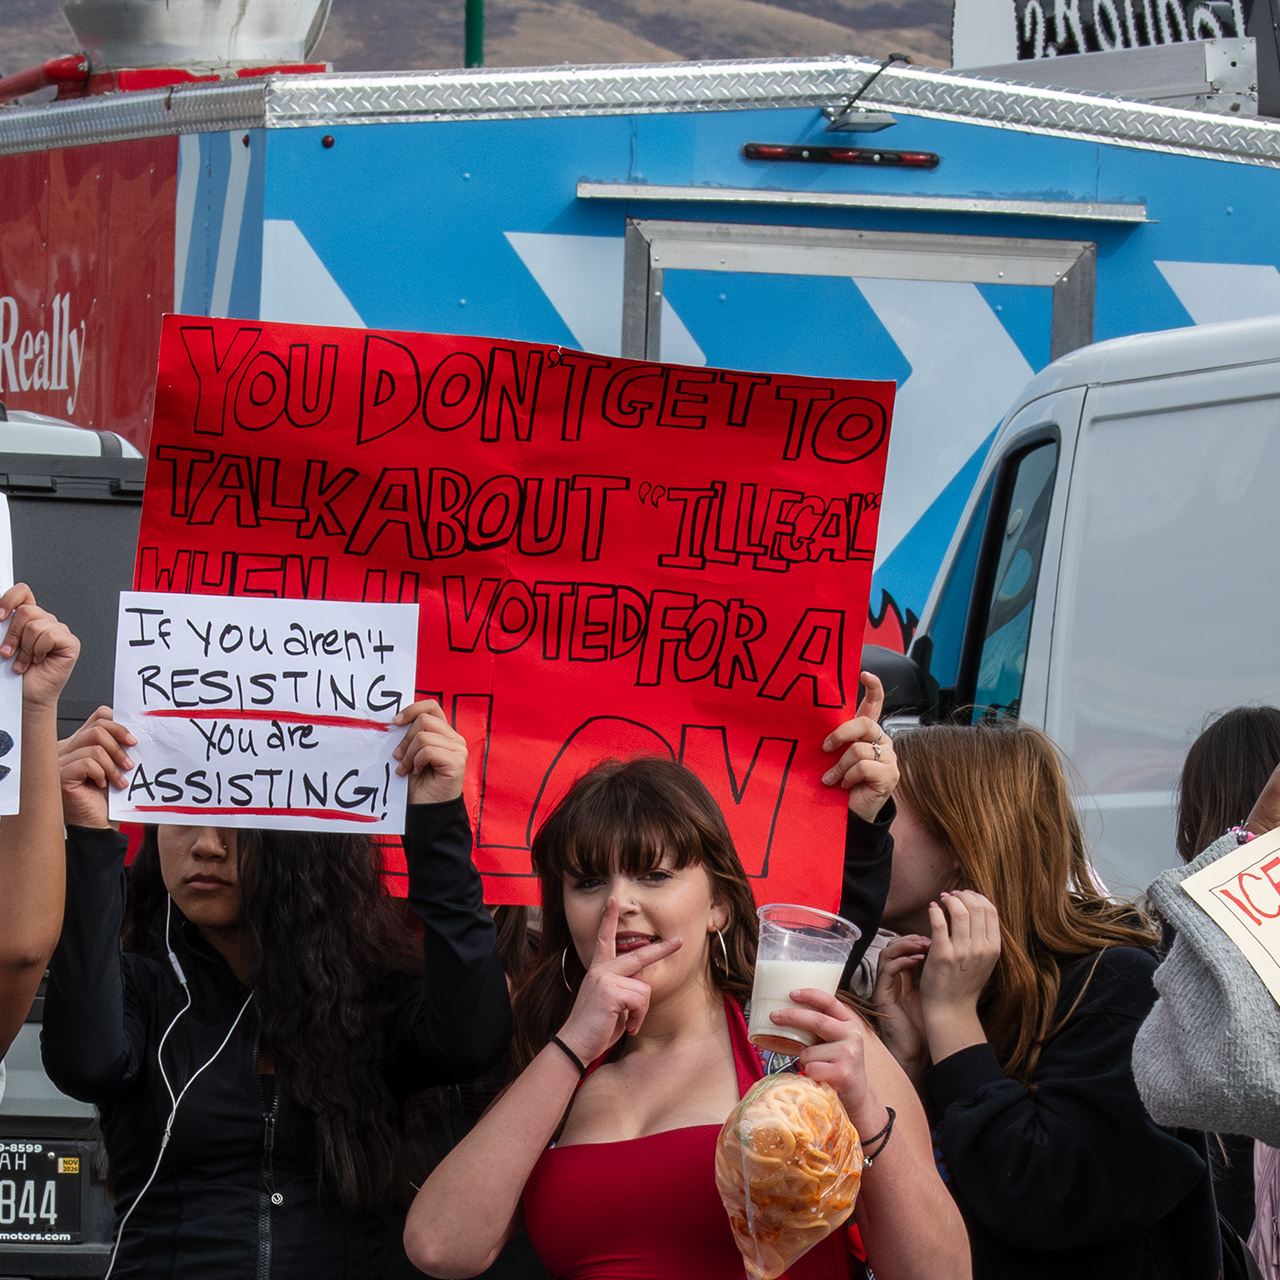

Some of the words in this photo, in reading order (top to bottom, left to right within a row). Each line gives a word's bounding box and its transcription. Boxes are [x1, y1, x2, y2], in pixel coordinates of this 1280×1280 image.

[180, 326, 339, 436] YOU
[357, 335, 611, 444] DON'T
[601, 365, 773, 430] GET
[770, 385, 888, 464] TO
[155, 445, 359, 540] TALK
[345, 467, 629, 562] ABOUT
[125, 607, 171, 650] If
[283, 622, 395, 664] aren't
[444, 574, 644, 663] VOTED
[635, 590, 767, 689] FOR
[760, 607, 847, 708] A
[137, 664, 402, 717] RESISTING
[266, 719, 319, 751] are
[128, 762, 390, 821] ASSISTING!
